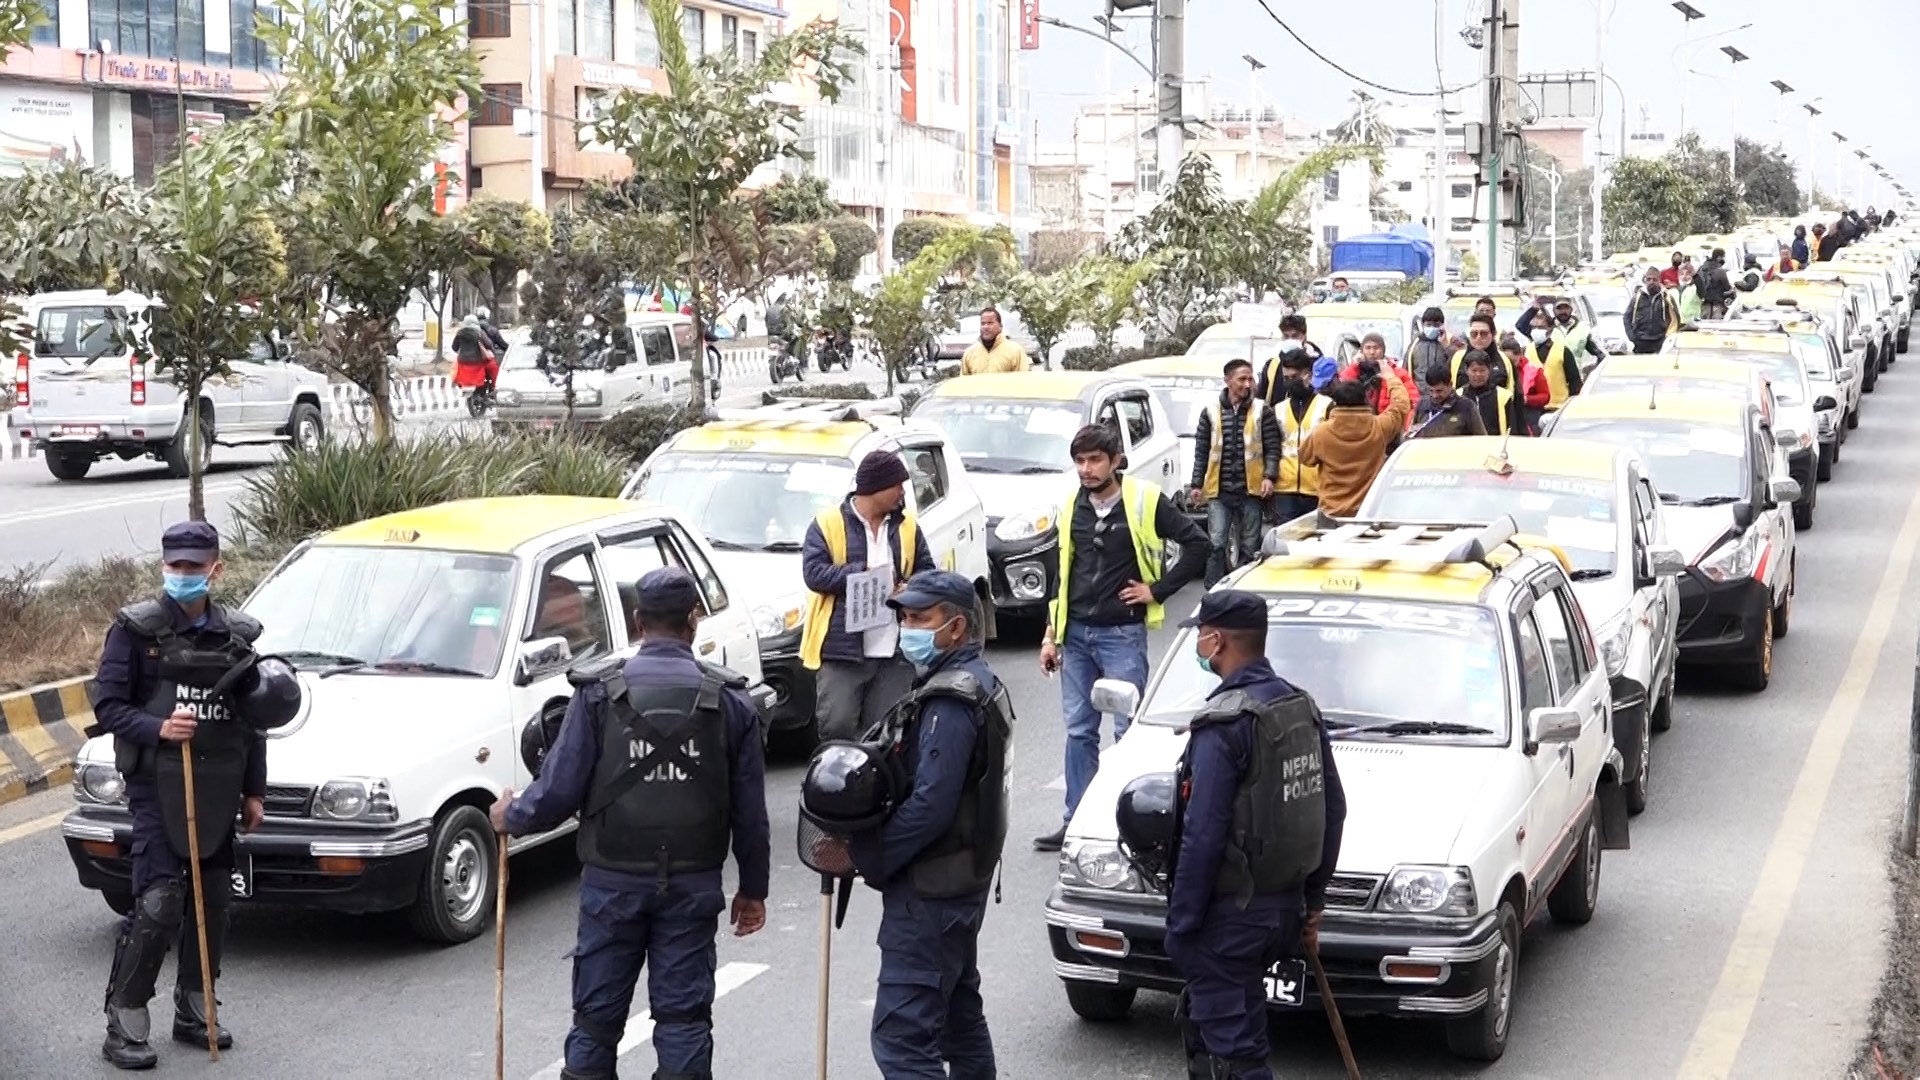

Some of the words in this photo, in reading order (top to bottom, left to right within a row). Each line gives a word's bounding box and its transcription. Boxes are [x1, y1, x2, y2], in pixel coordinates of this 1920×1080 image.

[1327, 578, 1355, 588] TAXI
[1321, 627, 1360, 640] TAXI
[176, 683, 223, 700] NEP
[629, 762, 700, 782] LIC
[1282, 752, 1321, 780] NEPAL
[1283, 773, 1322, 802] POLICE
